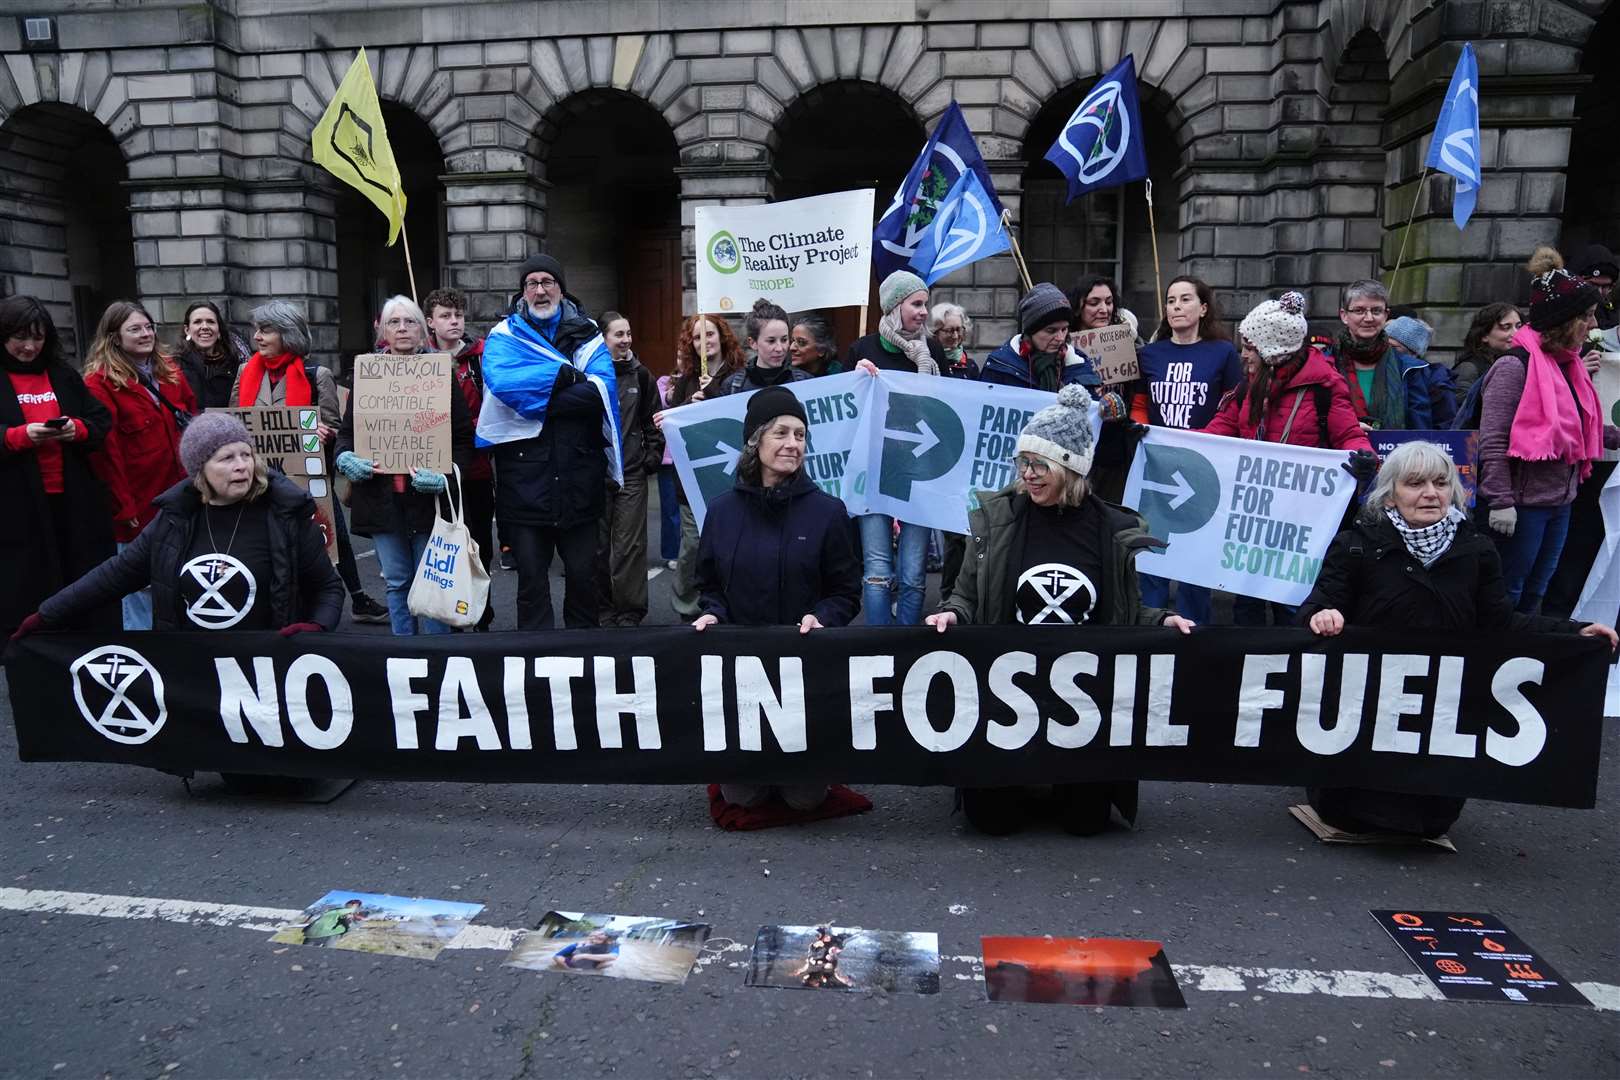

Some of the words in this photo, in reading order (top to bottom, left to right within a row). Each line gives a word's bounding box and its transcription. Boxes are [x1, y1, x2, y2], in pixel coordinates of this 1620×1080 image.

[738, 236, 766, 253] The
[768, 226, 845, 251] Climate
[742, 253, 800, 272] Reality
[804, 242, 859, 265] Project
[749, 277, 795, 290] EUROPE
[1072, 332, 1096, 348] TOP
[360, 361, 381, 376] NO
[383, 361, 418, 376] NEW
[420, 361, 446, 376] OIL
[1097, 367, 1112, 381] IL
[1165, 362, 1193, 382] FOR
[388, 380, 400, 393] IS
[403, 384, 420, 395] OR
[422, 378, 444, 392] GAS
[1150, 382, 1209, 406] FUTURE'S
[358, 394, 436, 410] COMPATIBLE
[804, 391, 858, 426] ENTS
[260, 410, 299, 431] HILL
[364, 418, 397, 432] WITH
[403, 418, 413, 432] A
[1160, 404, 1193, 429] SAKE
[254, 433, 301, 454] HAVEN
[369, 435, 436, 450] LIVEABLE
[974, 432, 1017, 462] FOR
[1378, 442, 1396, 452] NO
[1235, 454, 1339, 497] PARENTS
[1230, 483, 1274, 517] FOR
[1224, 512, 1313, 554] FUTURE
[430, 535, 443, 549] All
[443, 542, 461, 555] my
[425, 548, 456, 575] Lidl
[1220, 541, 1323, 585] SCOTLAN
[423, 568, 455, 589] things
[214, 653, 353, 749] NO
[386, 655, 661, 751] FAITH
[701, 654, 807, 753] IN
[849, 650, 1190, 753] FOSSIL
[1234, 652, 1547, 767] FUELS
